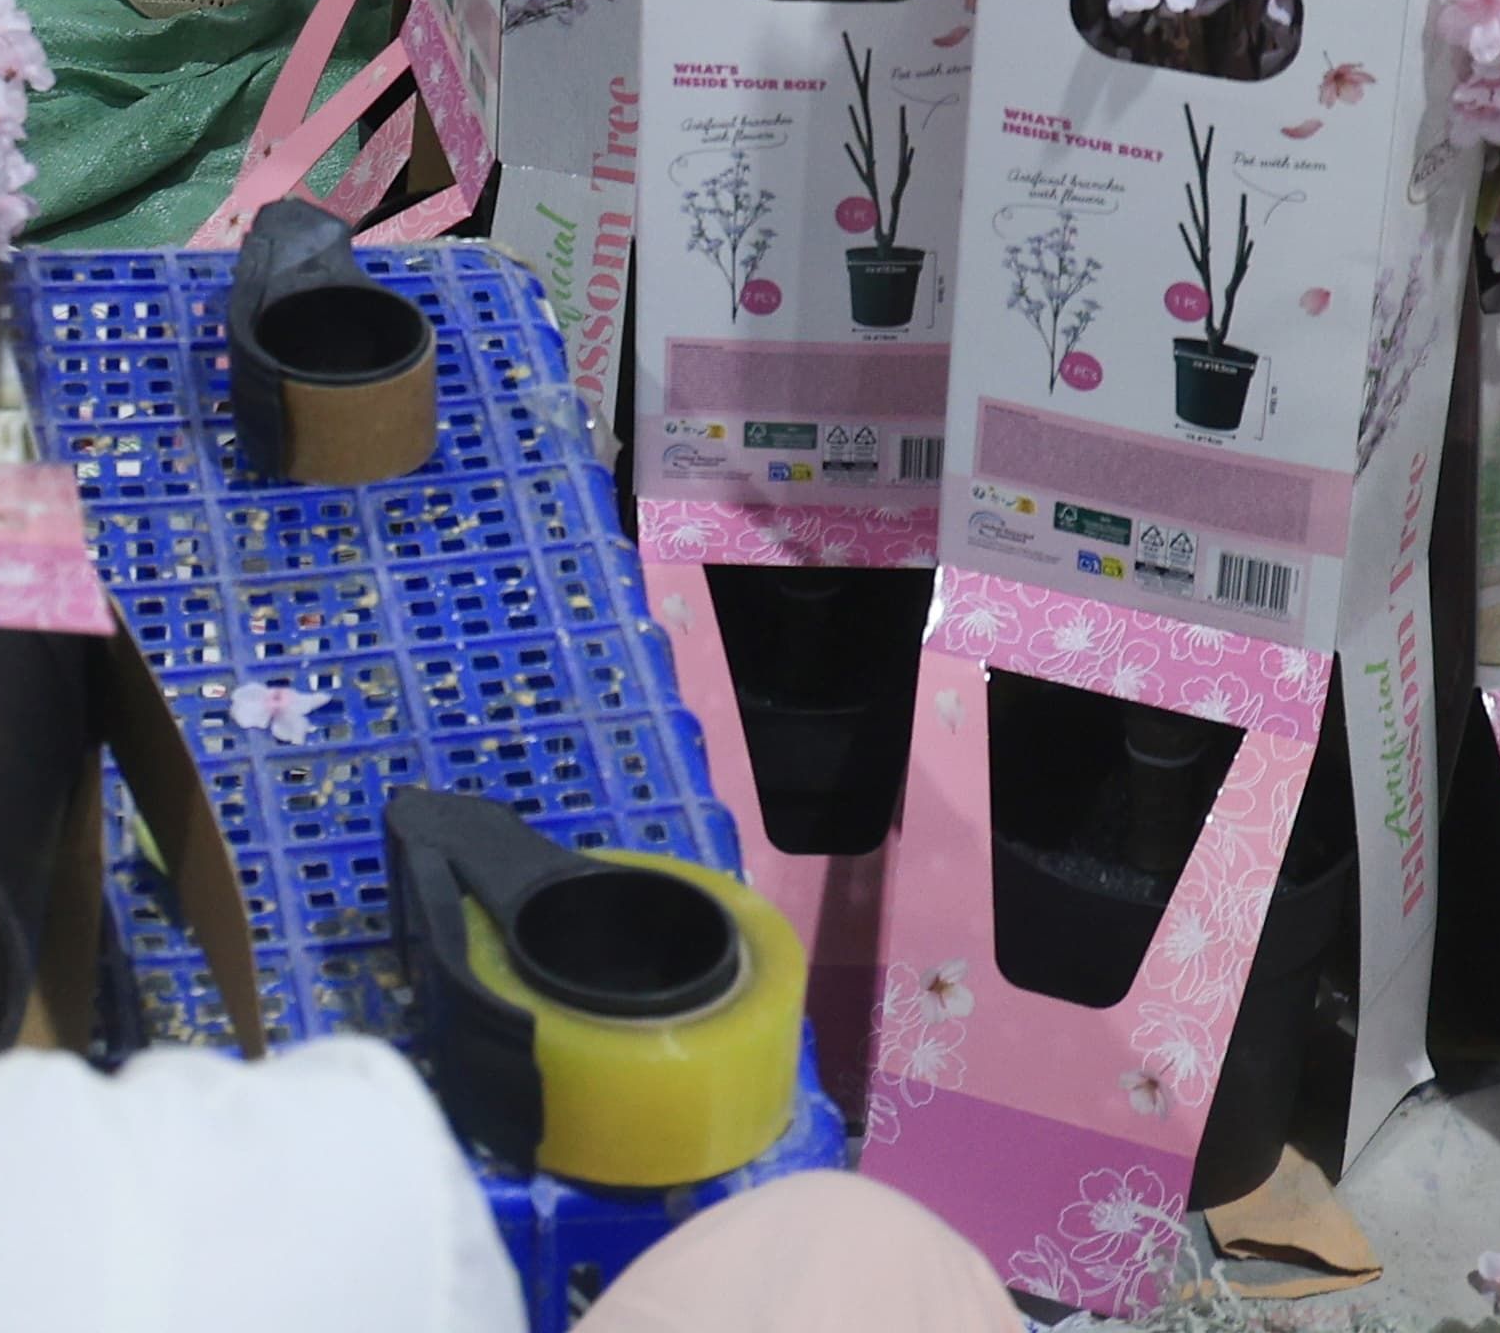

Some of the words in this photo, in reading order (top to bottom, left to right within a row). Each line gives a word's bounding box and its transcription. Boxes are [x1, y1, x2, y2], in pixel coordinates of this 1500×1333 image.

[674, 63, 739, 76] WHAT'S
[672, 76, 728, 88] INSIDE
[733, 78, 779, 90] YOUR
[783, 80, 828, 92] BOX?
[1003, 108, 1073, 131] WHAT'S
[591, 76, 640, 192] Tree
[1002, 121, 1061, 143] INSIDE
[1064, 133, 1114, 155] YOUR
[1117, 144, 1164, 163] BOX?
[1258, 153, 1291, 170] with
[1293, 160, 1328, 171] stem
[1028, 188, 1059, 201] with
[1060, 188, 1107, 206] flowers
[574, 211, 632, 407] ossom
